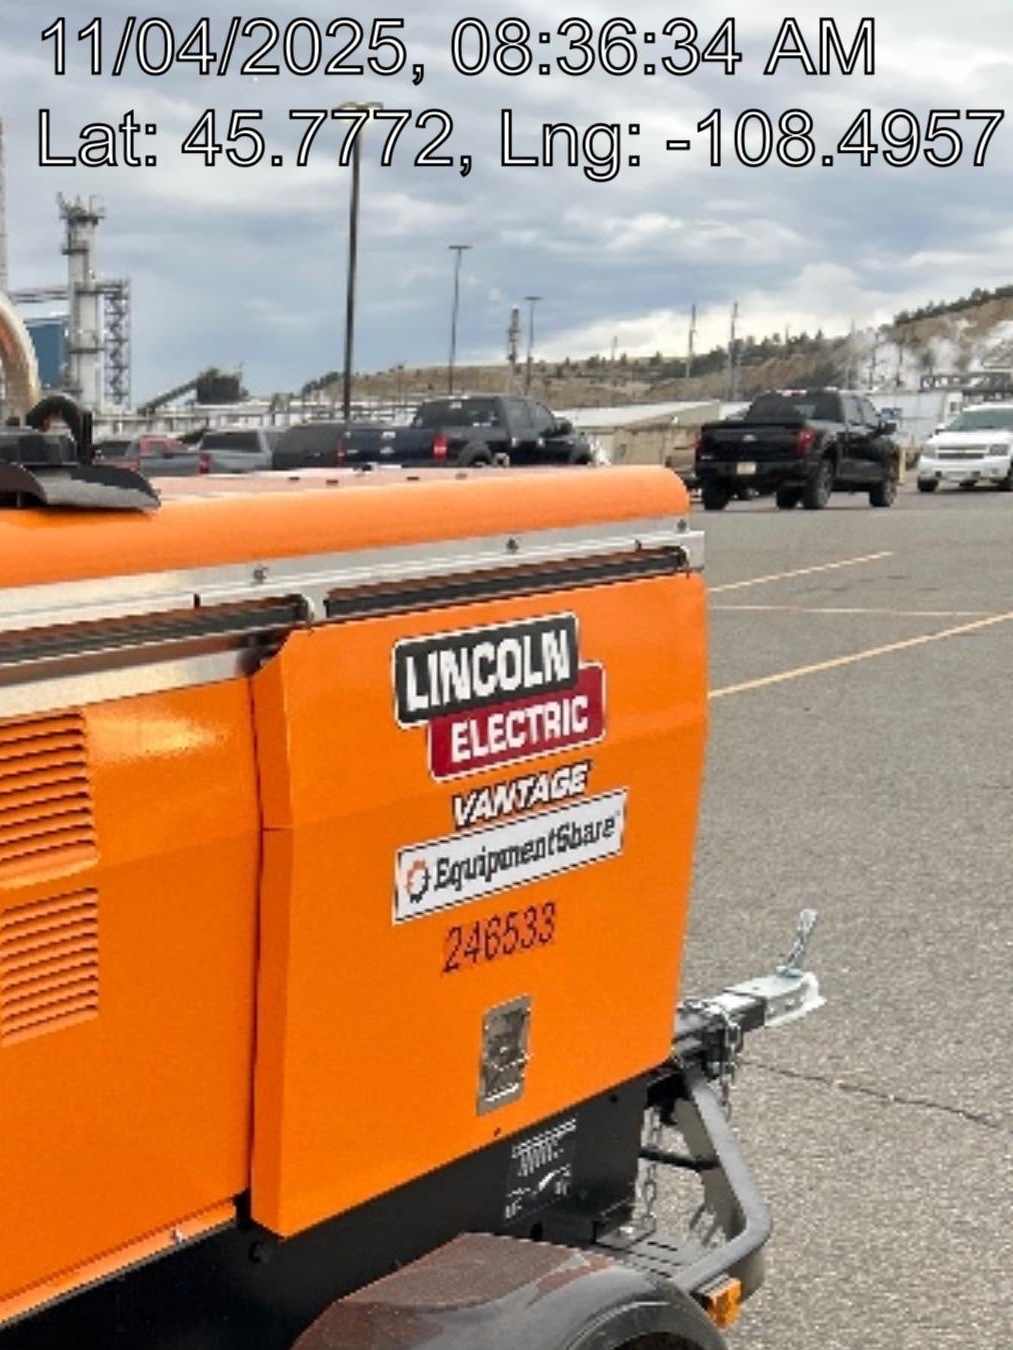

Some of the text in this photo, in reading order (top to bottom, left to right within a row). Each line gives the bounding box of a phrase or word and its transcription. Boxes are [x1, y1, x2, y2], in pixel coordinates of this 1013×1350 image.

[406, 629, 570, 711] LINCOLN
[451, 696, 588, 763] ELECTRIC
[452, 762, 590, 829] VANTAGE
[434, 816, 616, 891] EquipmentShare
[442, 902, 556, 974] 246533
